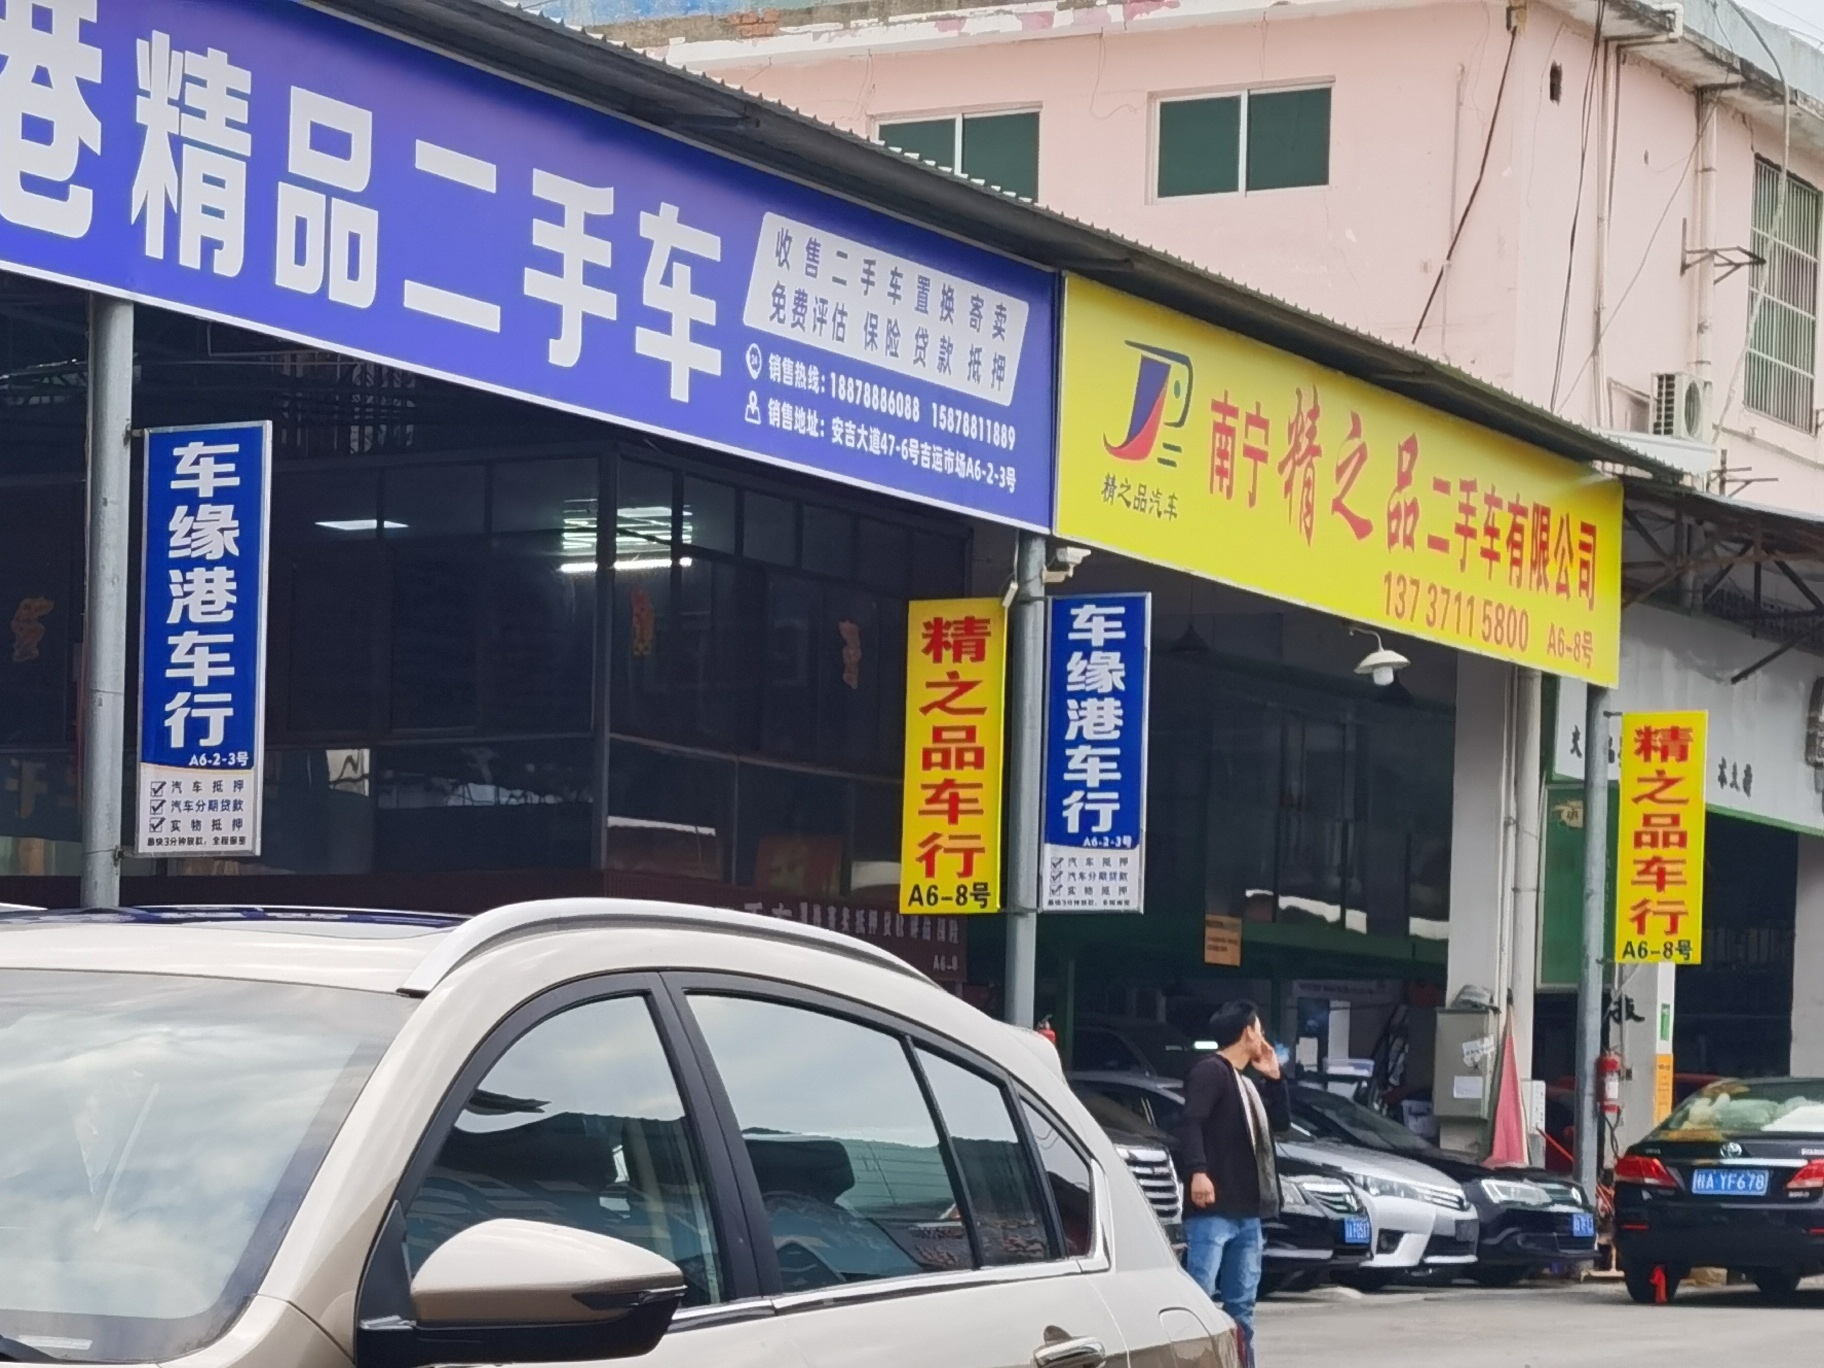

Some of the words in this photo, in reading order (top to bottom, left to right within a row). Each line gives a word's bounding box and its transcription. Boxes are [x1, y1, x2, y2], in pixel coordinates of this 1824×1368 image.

[932, 403, 1016, 451] 15878811889
[1102, 473, 1178, 521] 精之品汽车
[164, 442, 240, 748] 车缘港车行
[1546, 622, 1593, 669] A6-8号
[1063, 604, 1126, 833] 车缘港车行
[189, 752, 249, 767] A6-2-3号
[915, 615, 992, 879] 精之品车行
[1629, 725, 1693, 937] 精之品车行
[908, 882, 991, 909] A6-8号
[1622, 939, 1693, 961] A6-8号
